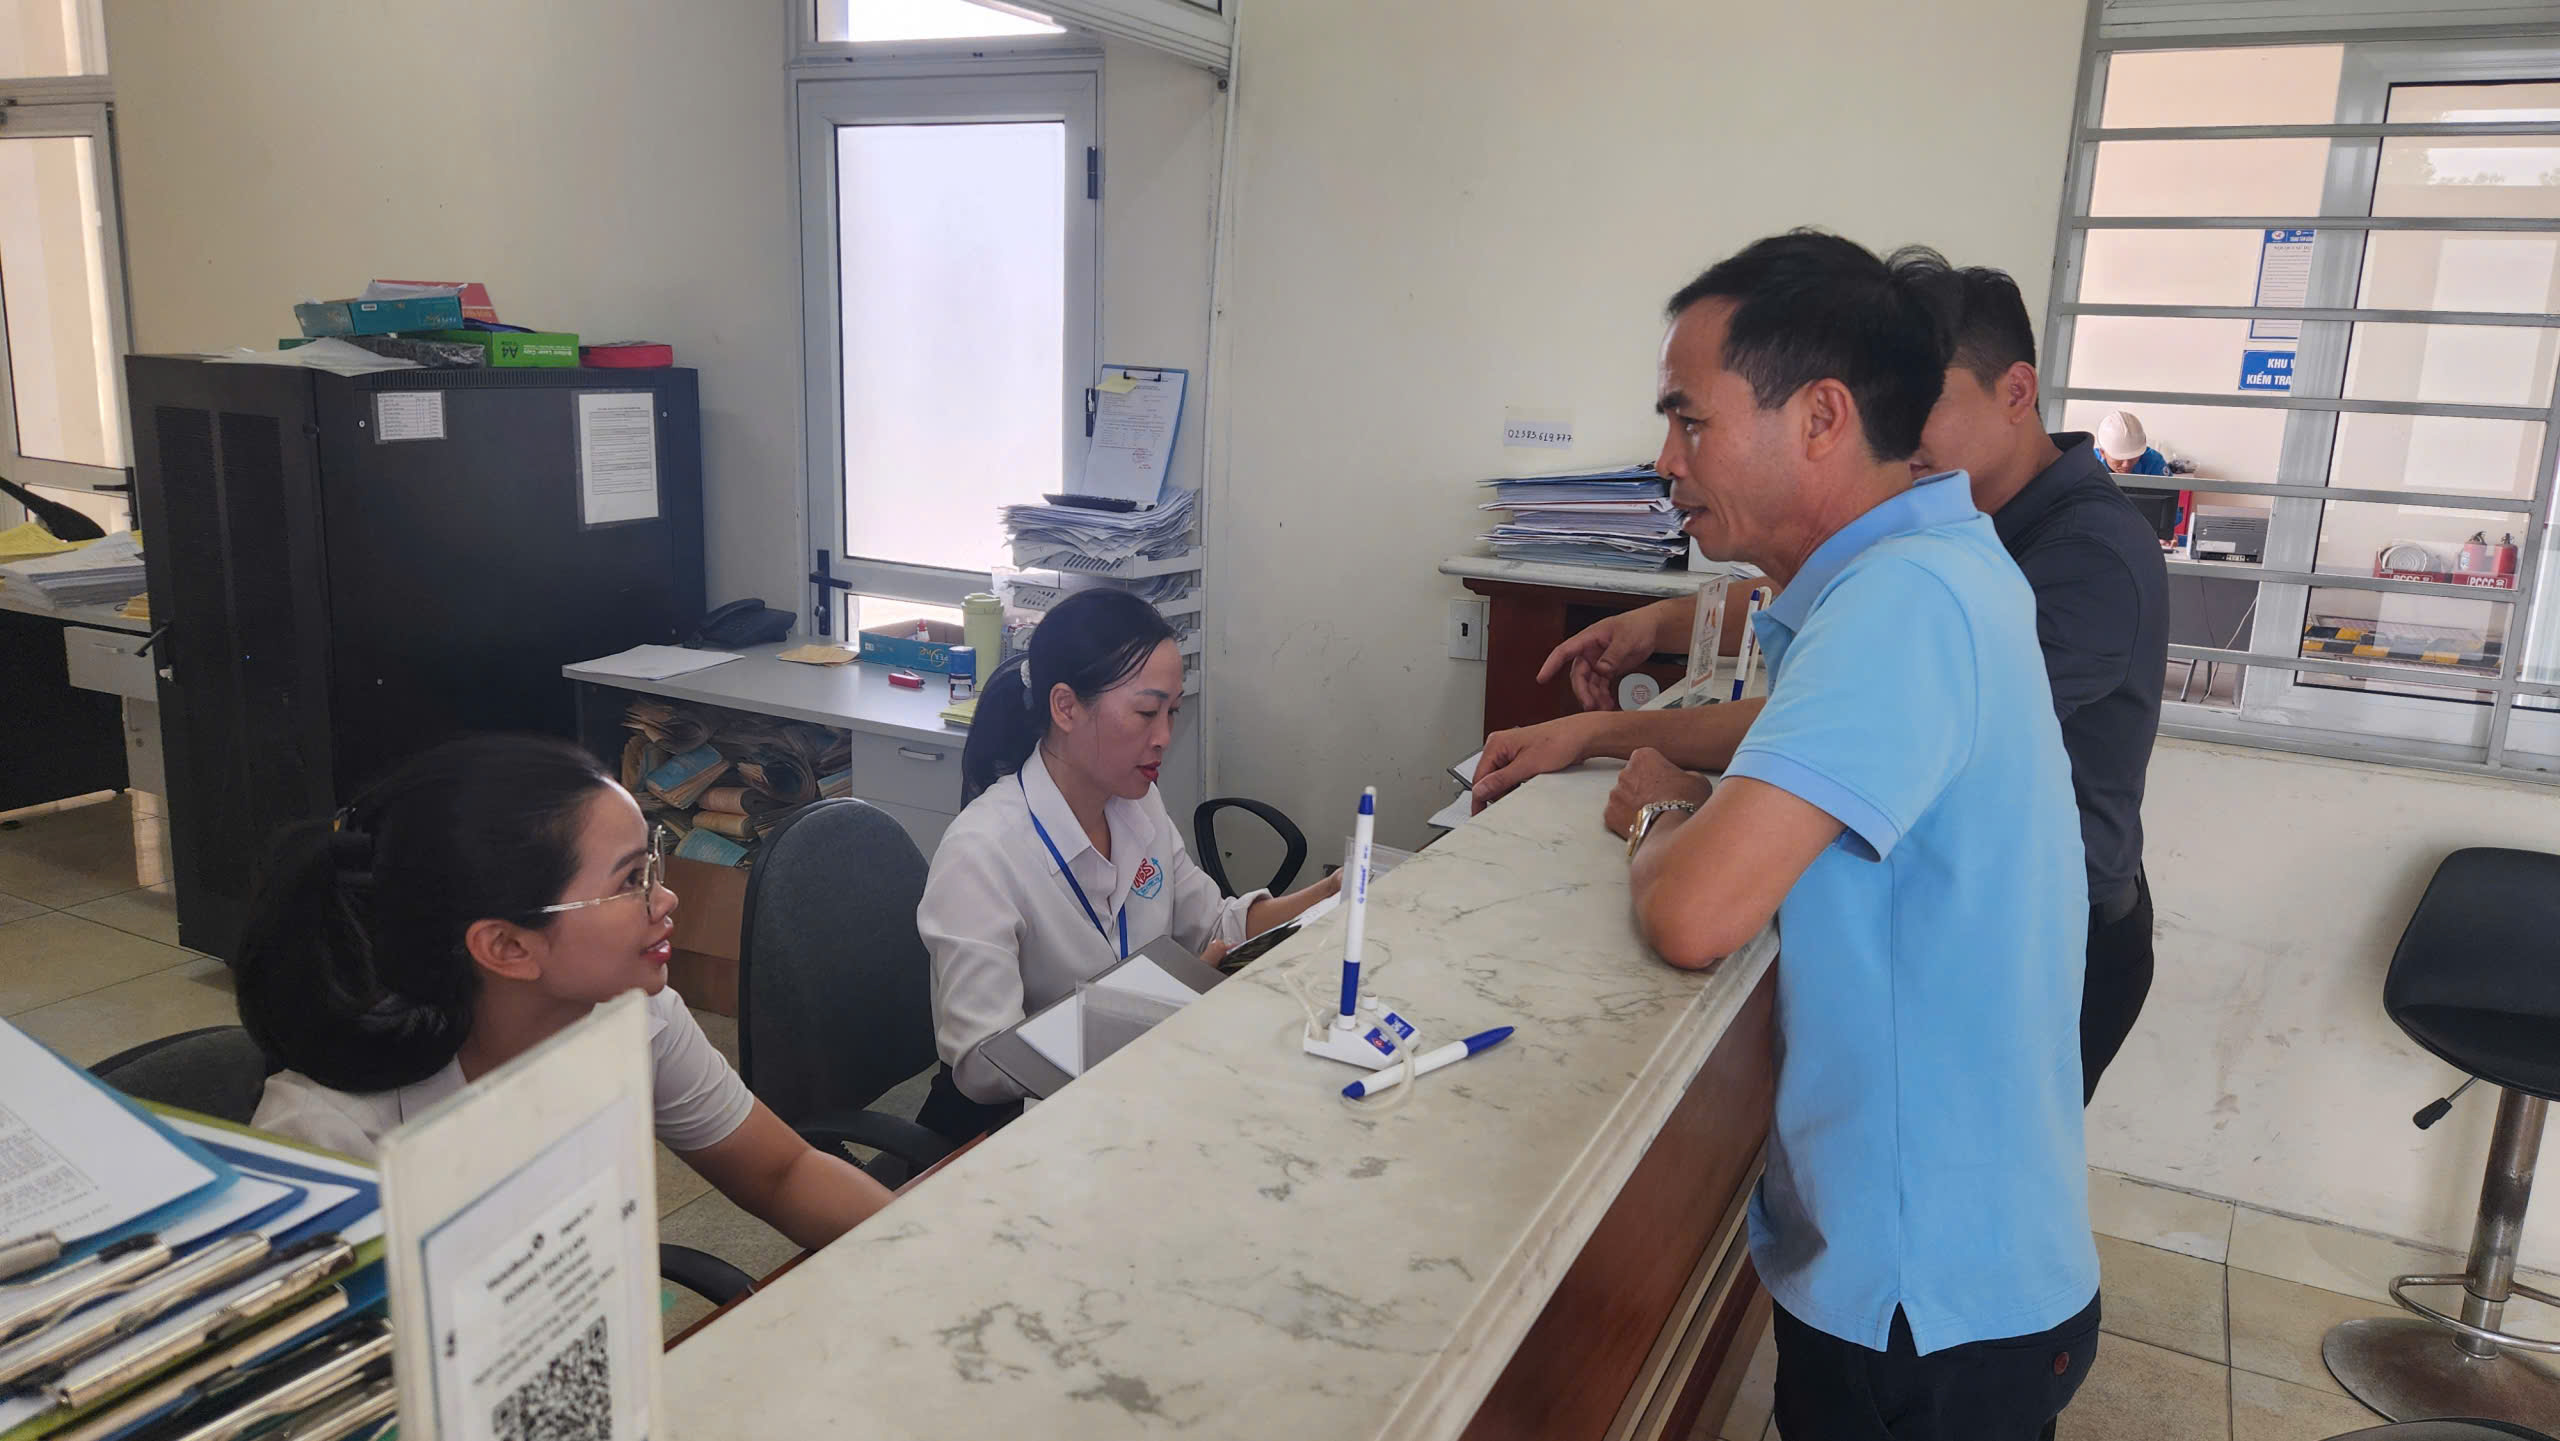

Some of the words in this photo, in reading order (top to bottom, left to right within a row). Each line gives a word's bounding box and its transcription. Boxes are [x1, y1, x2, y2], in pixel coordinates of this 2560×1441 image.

[502, 346, 519, 359] A4
[2267, 358, 2289, 369] KHU
[2469, 575, 2496, 588] PCCC
